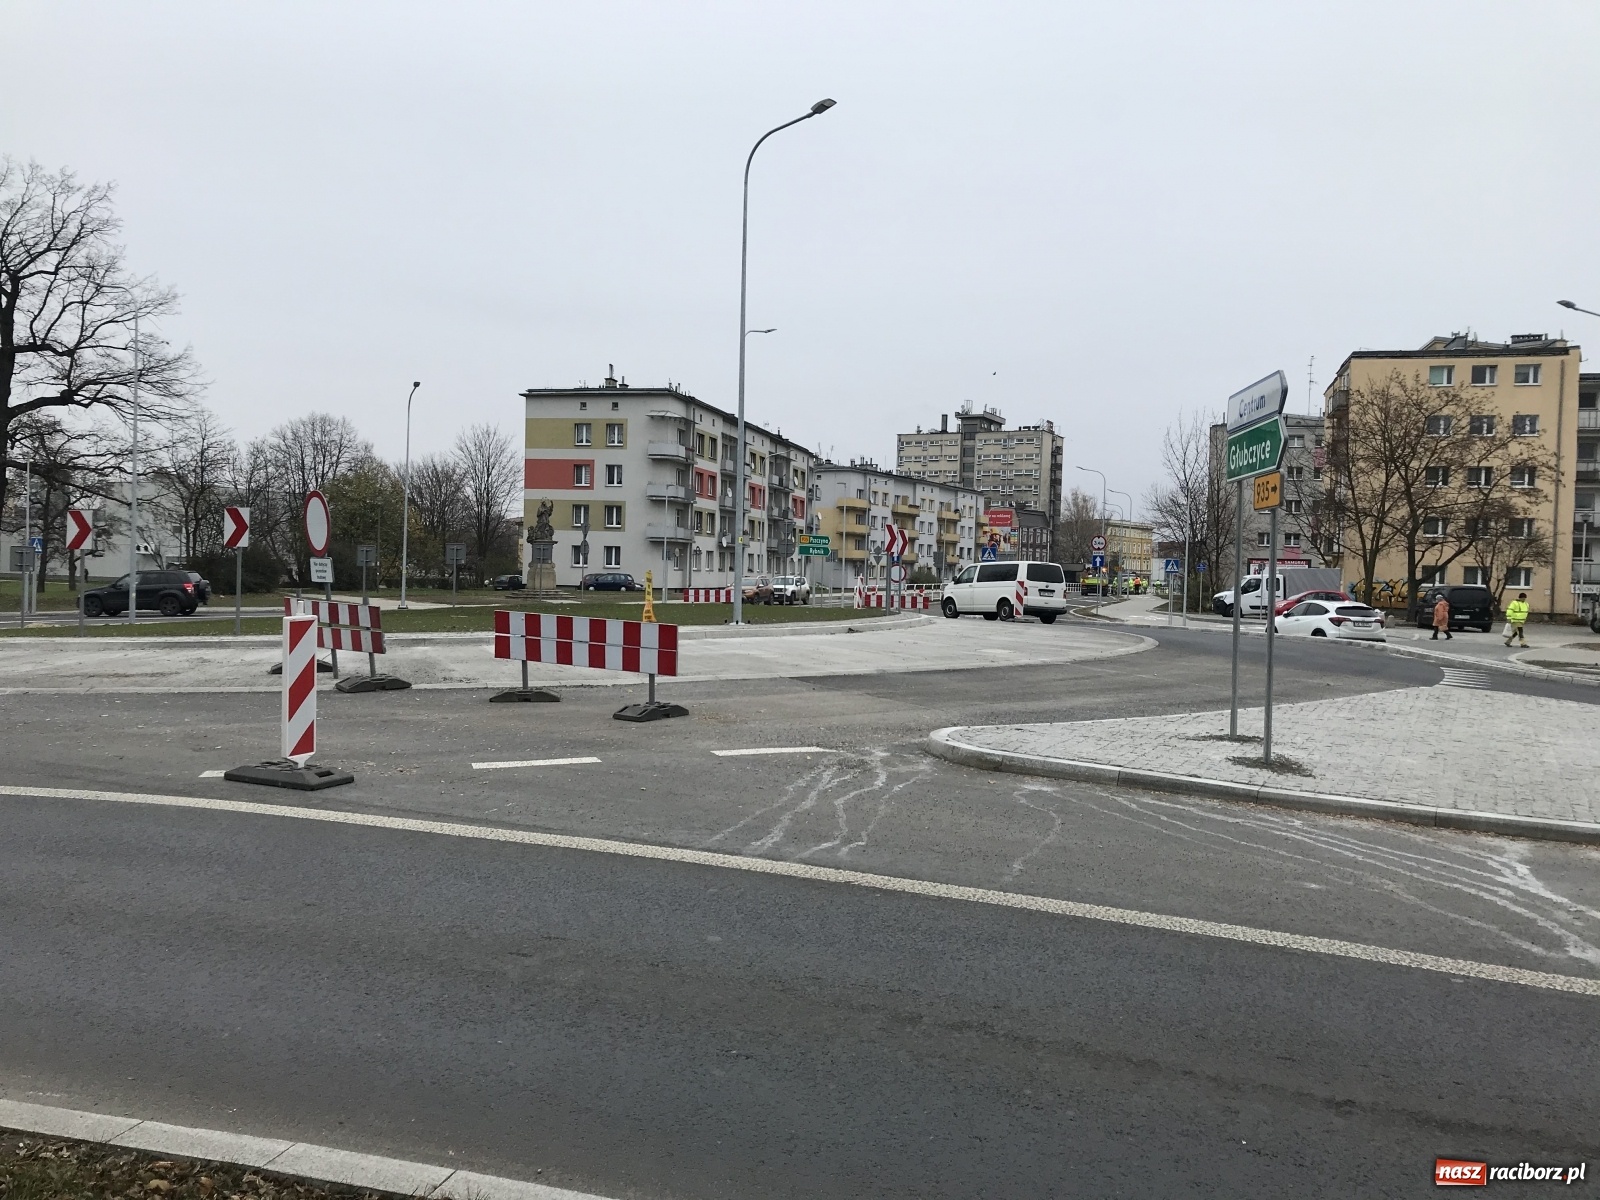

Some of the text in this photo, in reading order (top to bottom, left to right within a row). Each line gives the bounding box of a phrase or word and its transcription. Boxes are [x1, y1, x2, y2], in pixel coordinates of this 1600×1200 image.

[1238, 394, 1266, 418] Centrum
[1229, 439, 1271, 470] Głubczyce
[1256, 480, 1270, 504] 935
[809, 547, 824, 555] Rybnik
[810, 537, 829, 545] Pszczyna
